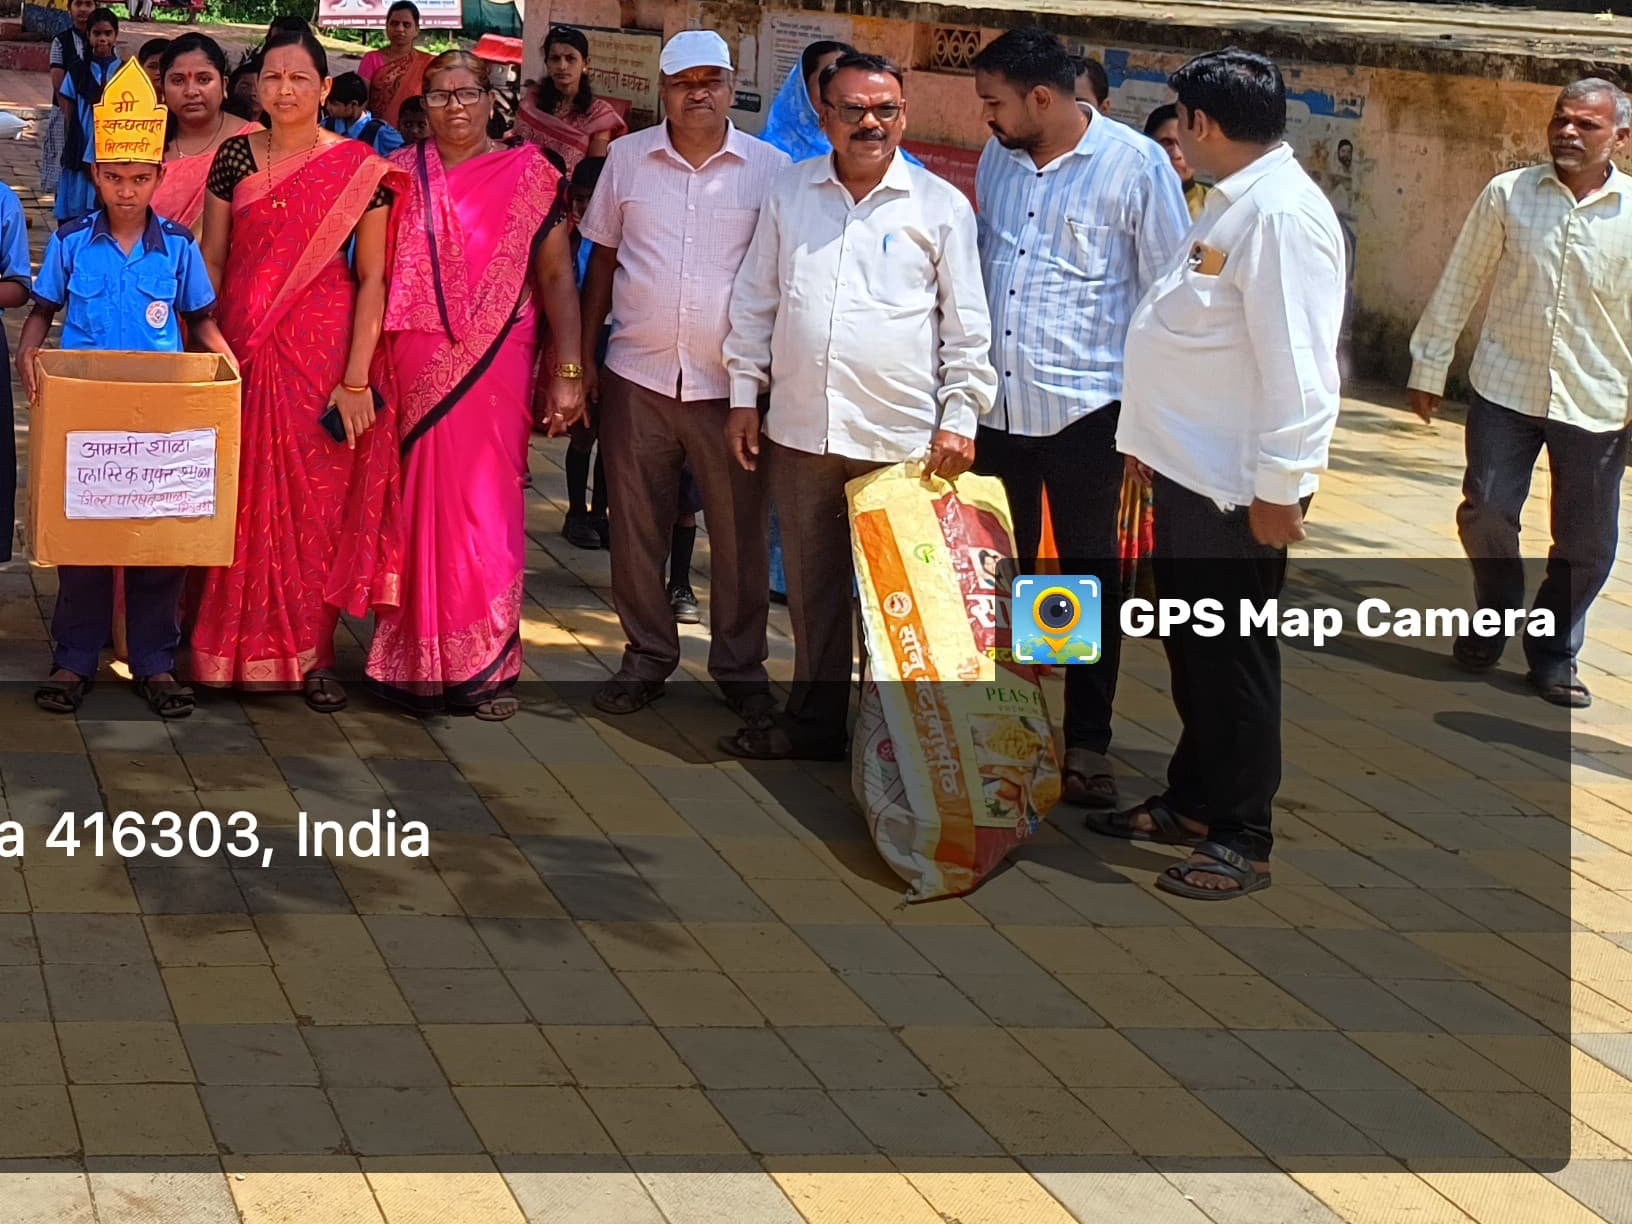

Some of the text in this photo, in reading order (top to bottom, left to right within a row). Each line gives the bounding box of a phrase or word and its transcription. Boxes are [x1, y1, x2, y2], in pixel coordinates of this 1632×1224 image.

[80, 436, 194, 458] आमची शाळा
[986, 687, 1029, 705] PEAS
